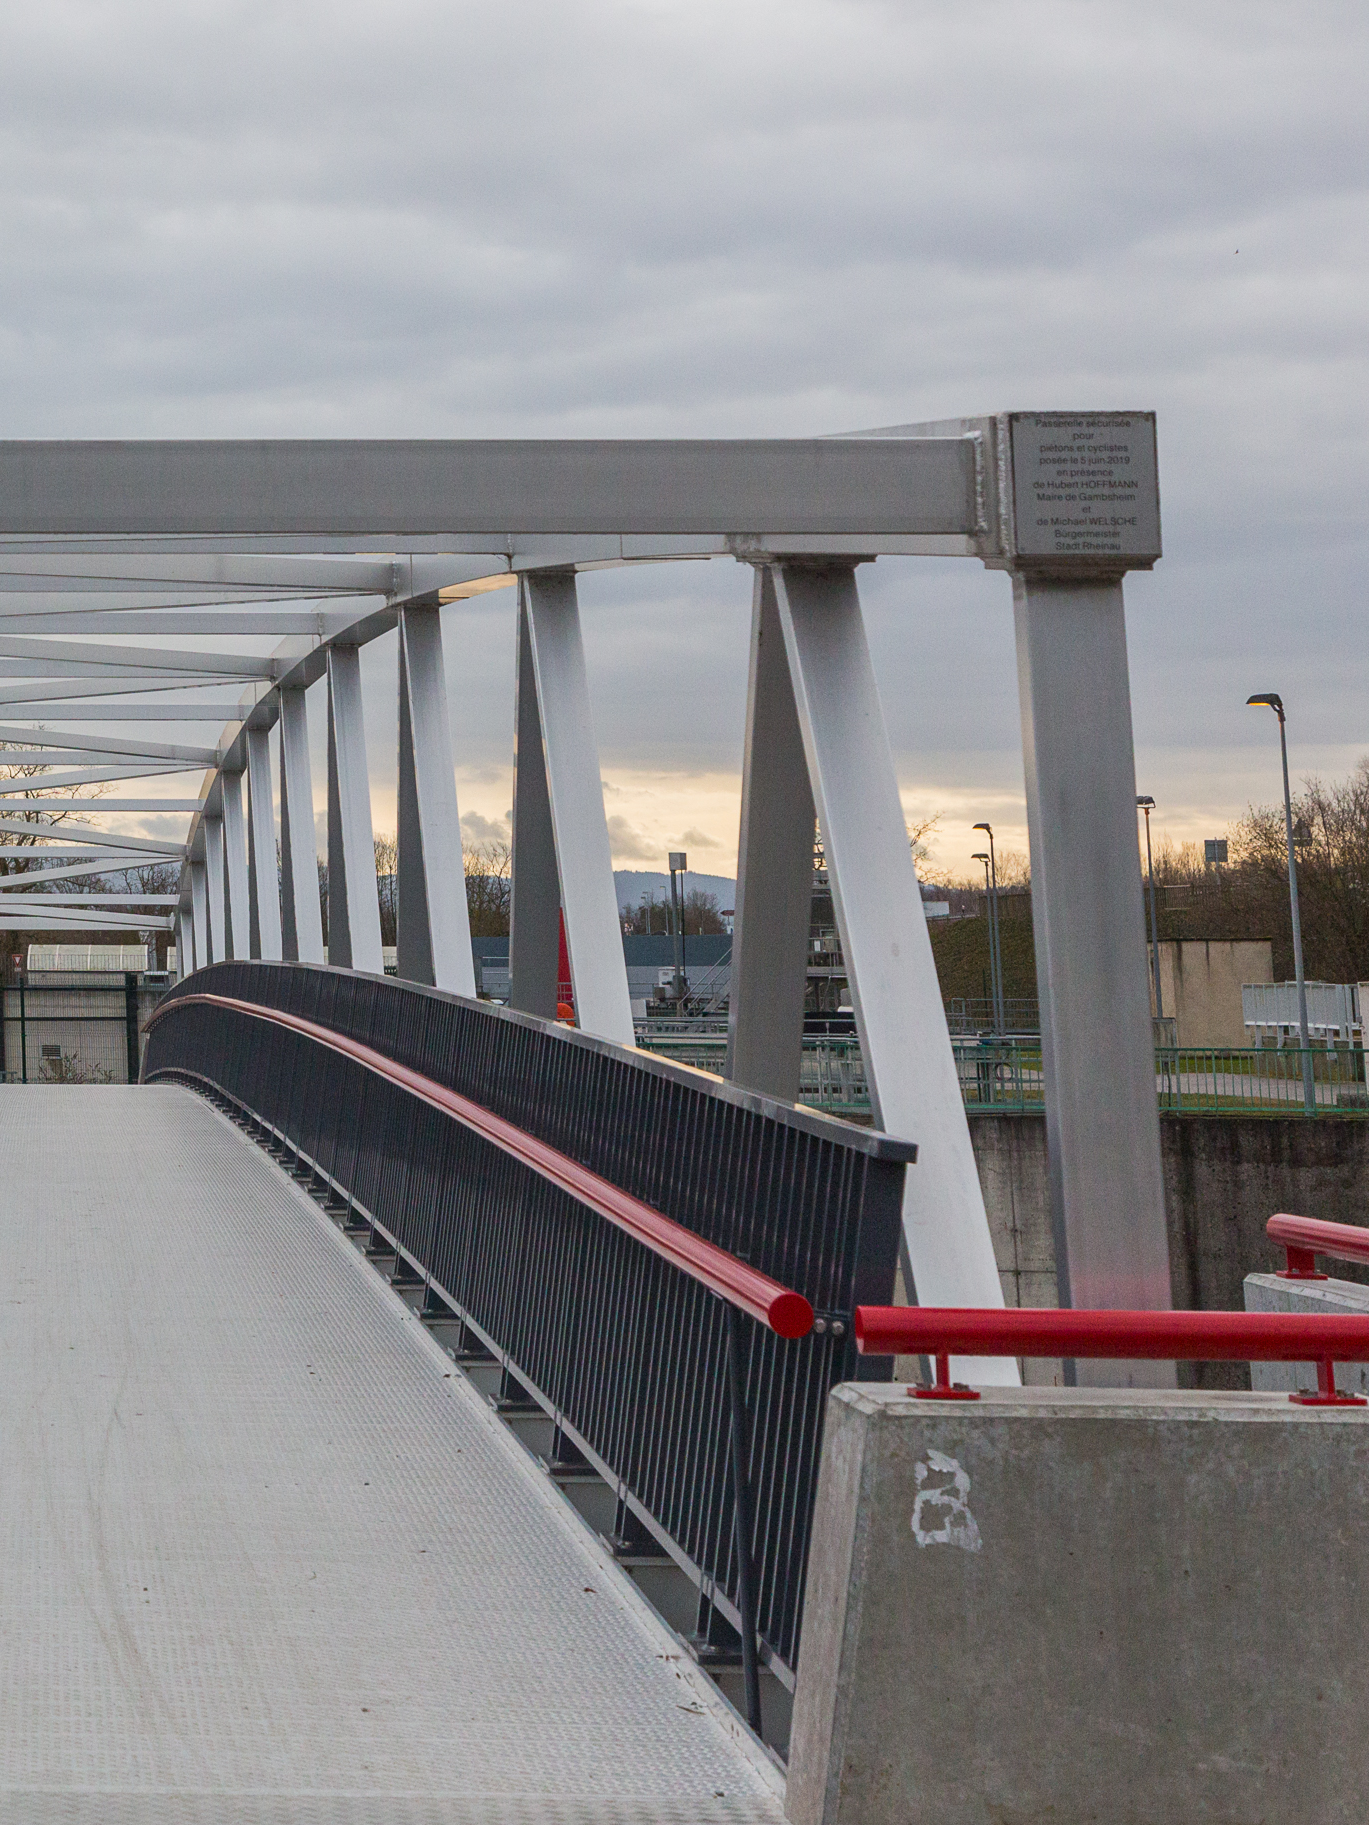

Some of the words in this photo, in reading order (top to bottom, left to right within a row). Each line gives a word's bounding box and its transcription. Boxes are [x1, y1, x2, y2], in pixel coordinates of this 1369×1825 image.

[1036, 419, 1083, 427] Passerelle
[1086, 419, 1131, 428] sécurisée
[1073, 433, 1094, 441] pour
[1040, 445, 1074, 453] piétons
[1088, 444, 1128, 453] cyclistes
[1039, 456, 1068, 465] posée
[1071, 456, 1078, 464] le
[1081, 456, 1086, 464] 5
[1088, 456, 1105, 465] juin
[1107, 456, 1130, 464] 2019
[1071, 469, 1113, 478] présence
[1033, 481, 1045, 489] de
[1047, 481, 1078, 489] Hubert
[1081, 480, 1138, 489] HOFFMANN
[1037, 493, 1063, 501] Maire
[1065, 493, 1077, 501] de
[1079, 492, 1135, 501] Gambsheim
[1051, 517, 1088, 525] Michael
[1089, 517, 1137, 525] WELSCHE
[1055, 529, 1121, 539] Bürgermeister
[1056, 542, 1080, 550] Stadt
[1082, 542, 1121, 550] Rheinau
